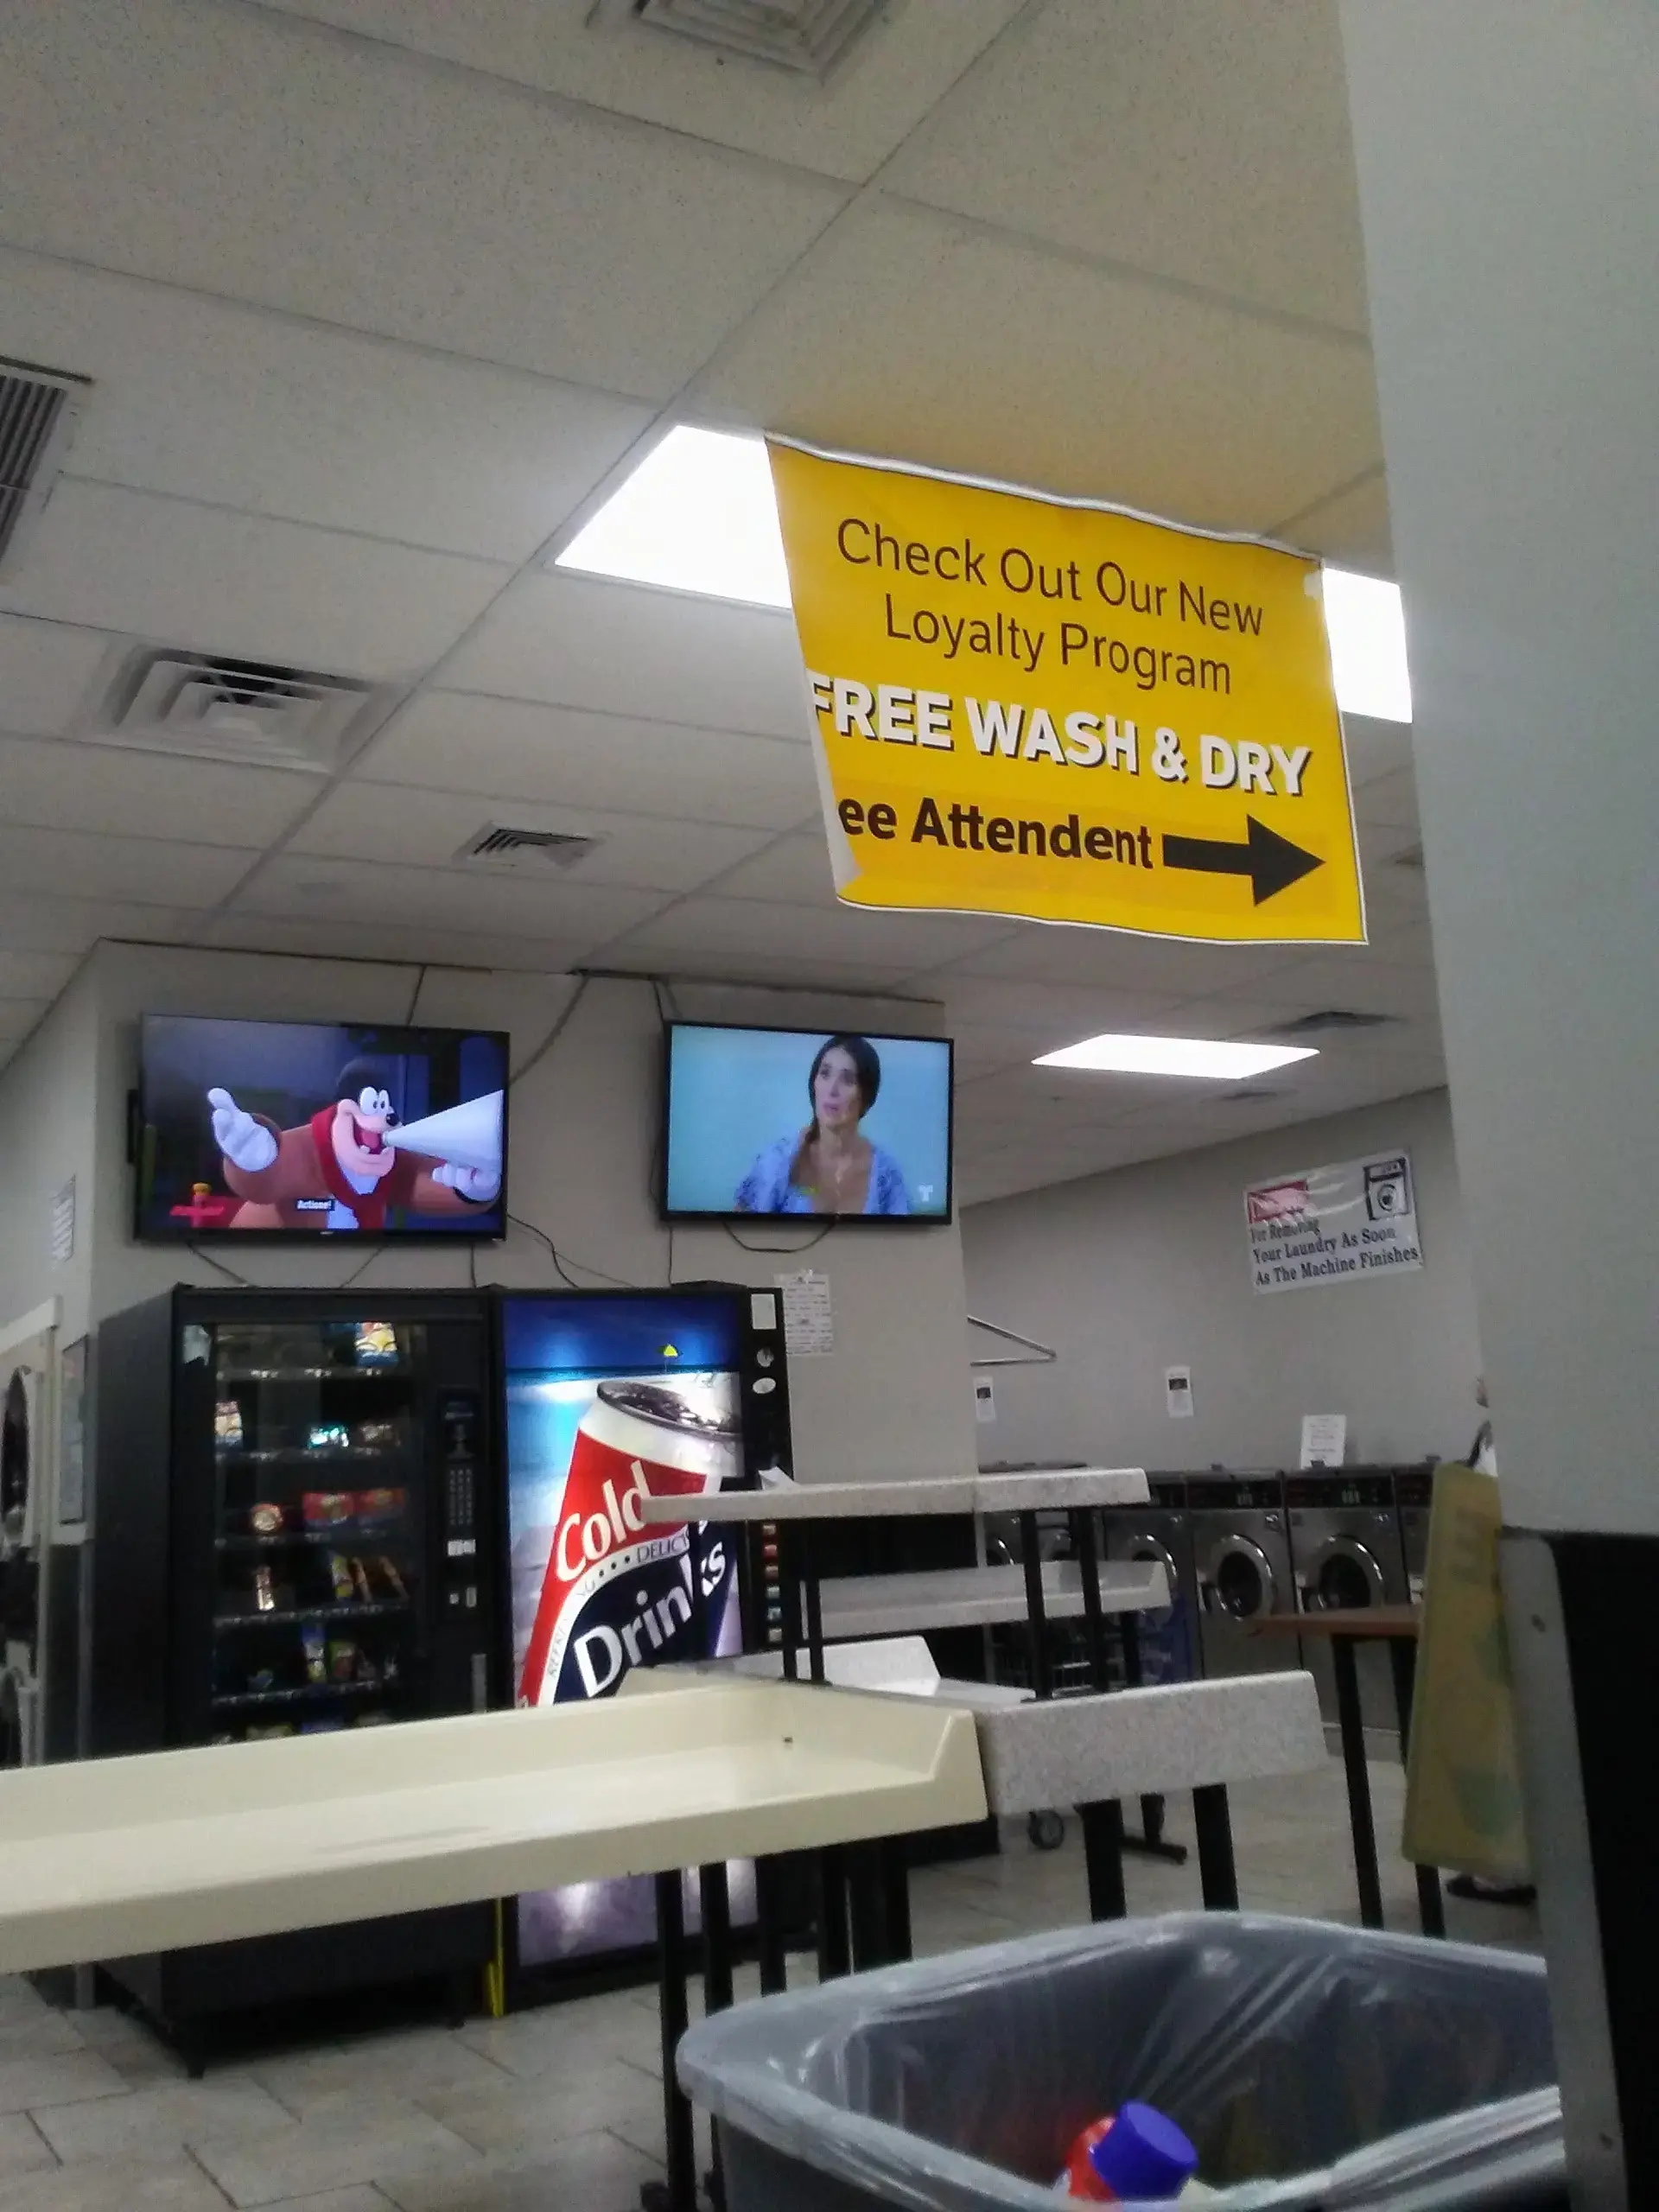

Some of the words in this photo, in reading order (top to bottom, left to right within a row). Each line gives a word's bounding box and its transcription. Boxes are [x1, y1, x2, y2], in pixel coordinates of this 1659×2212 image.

[838, 518, 985, 585] Check
[1000, 549, 1081, 602] Out
[1096, 561, 1167, 616] Our
[1179, 581, 1263, 636] New
[885, 594, 1045, 672] Loyalty
[1062, 623, 1233, 695] Program
[806, 668, 955, 752] FREE
[966, 696, 1139, 775] WASH
[1152, 728, 1188, 783] &
[1200, 734, 1313, 797] DRY
[838, 797, 898, 840] ee
[911, 797, 1154, 869] Attendent
[1253, 1248, 1282, 1264] Your
[1284, 1236, 1337, 1259] Laundry
[1341, 1231, 1358, 1249] As
[1361, 1226, 1396, 1245] Soon
[1255, 1269, 1270, 1286] As
[1274, 1265, 1297, 1282] The
[1300, 1257, 1356, 1279] Machine
[1359, 1245, 1419, 1269] Finishes
[555, 1460, 653, 1582] Cold
